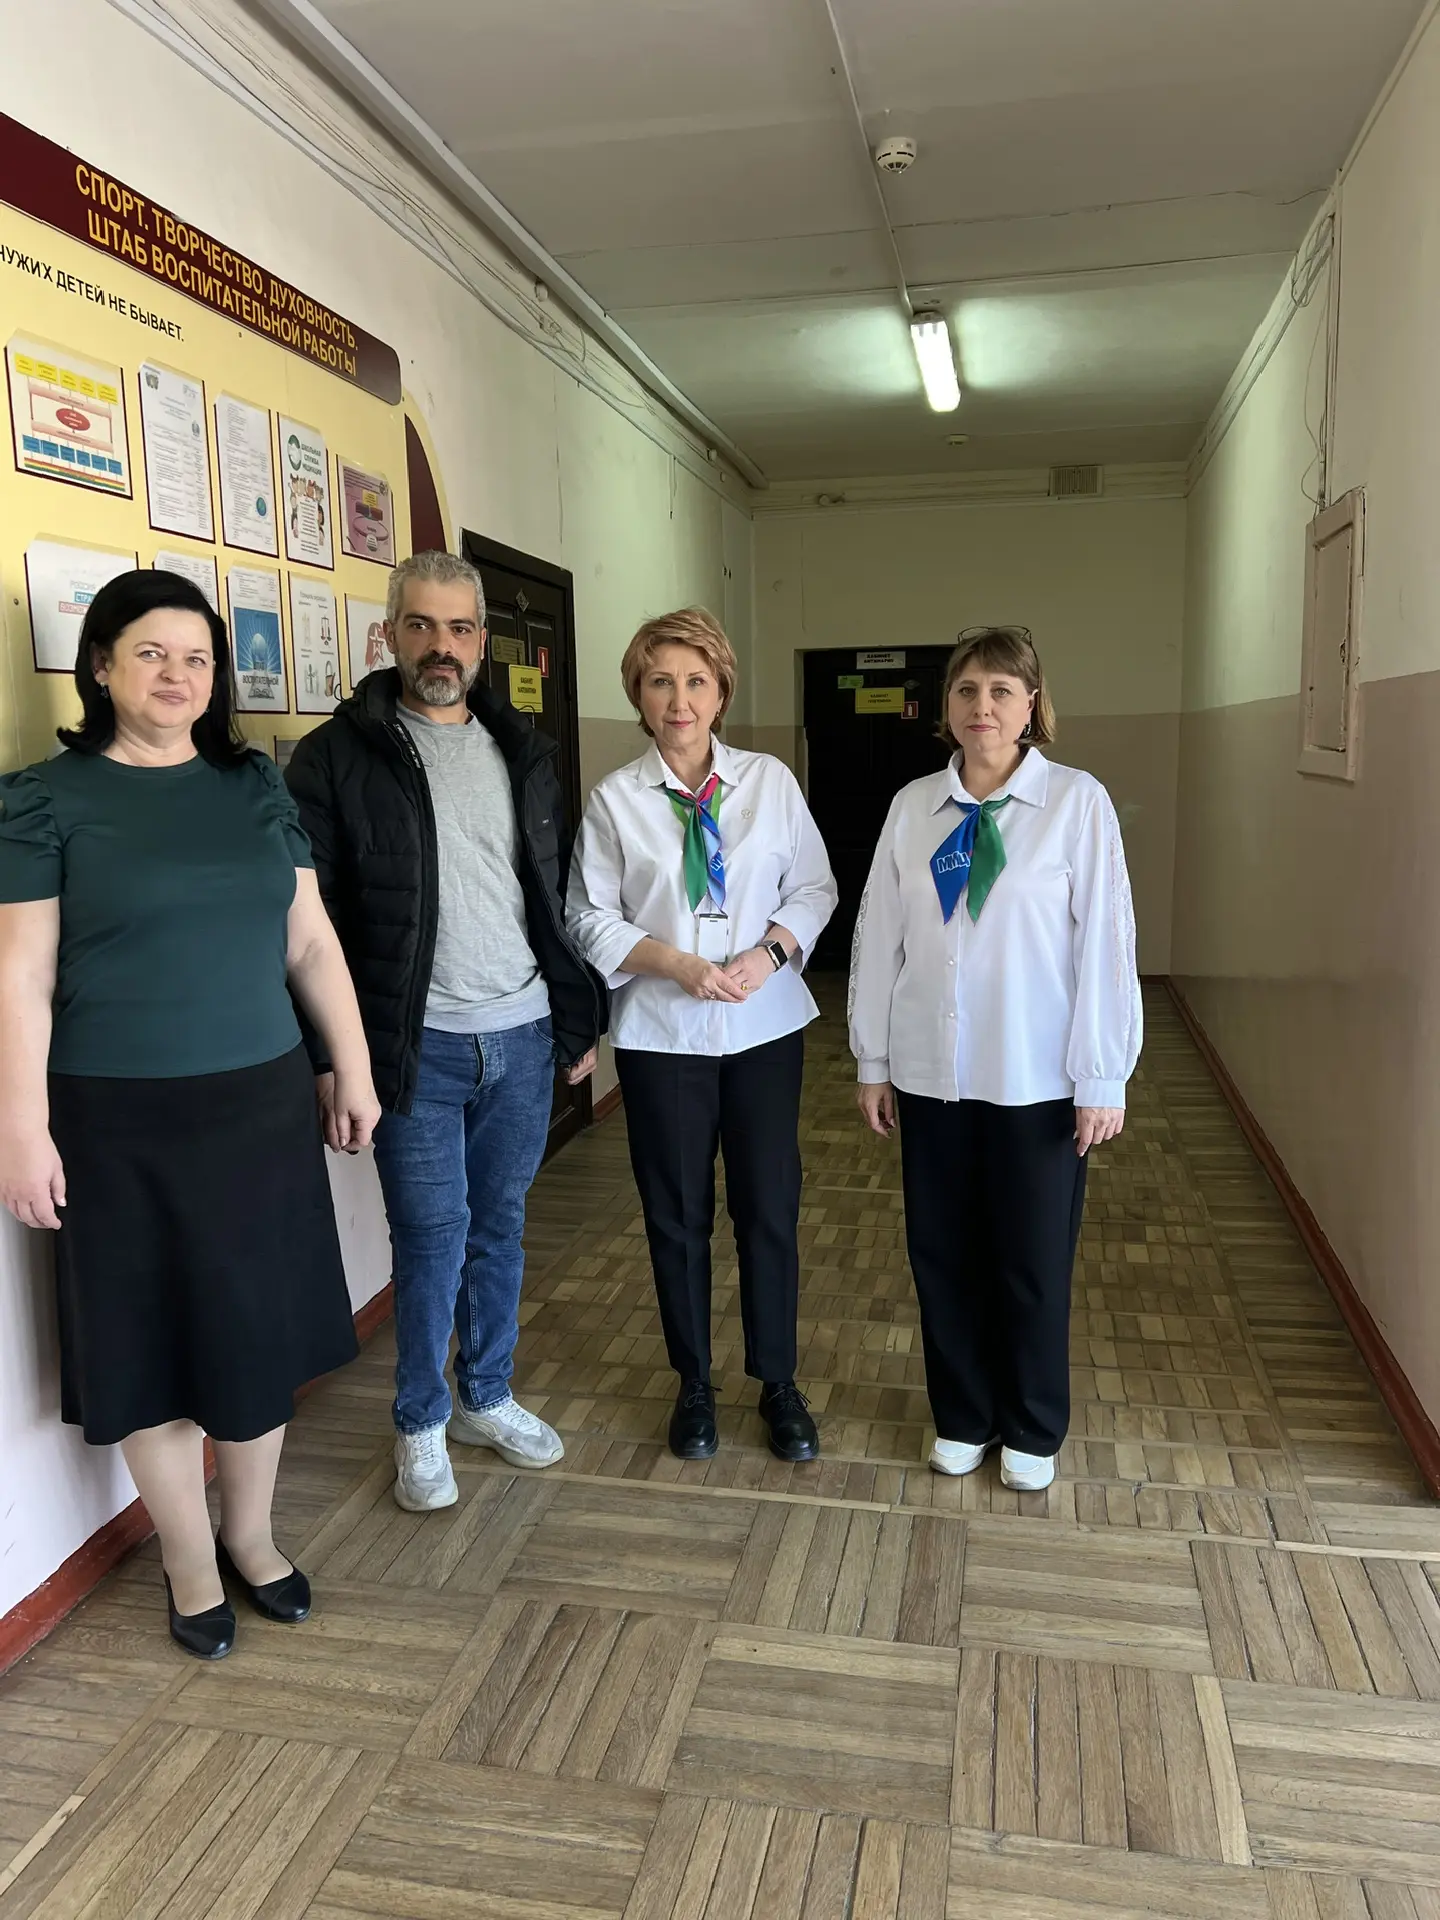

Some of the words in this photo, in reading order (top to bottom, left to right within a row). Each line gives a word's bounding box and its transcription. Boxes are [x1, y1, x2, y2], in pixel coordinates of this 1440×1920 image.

[56, 269, 105, 306] ДЕТЕЙ
[108, 293, 127, 316] НЕ
[130, 303, 184, 342] БЫВАЕТ.
[76, 164, 149, 231] СПОРТ.
[151, 207, 267, 298] ТВОРЧЕСТВО.
[269, 279, 358, 351] ДУХОВНОСТЬ.
[88, 208, 148, 266] ШТАБ
[151, 243, 301, 348] ВОСПИТАТЕЛЬНОЙ
[303, 328, 357, 377] РАБОТЫ
